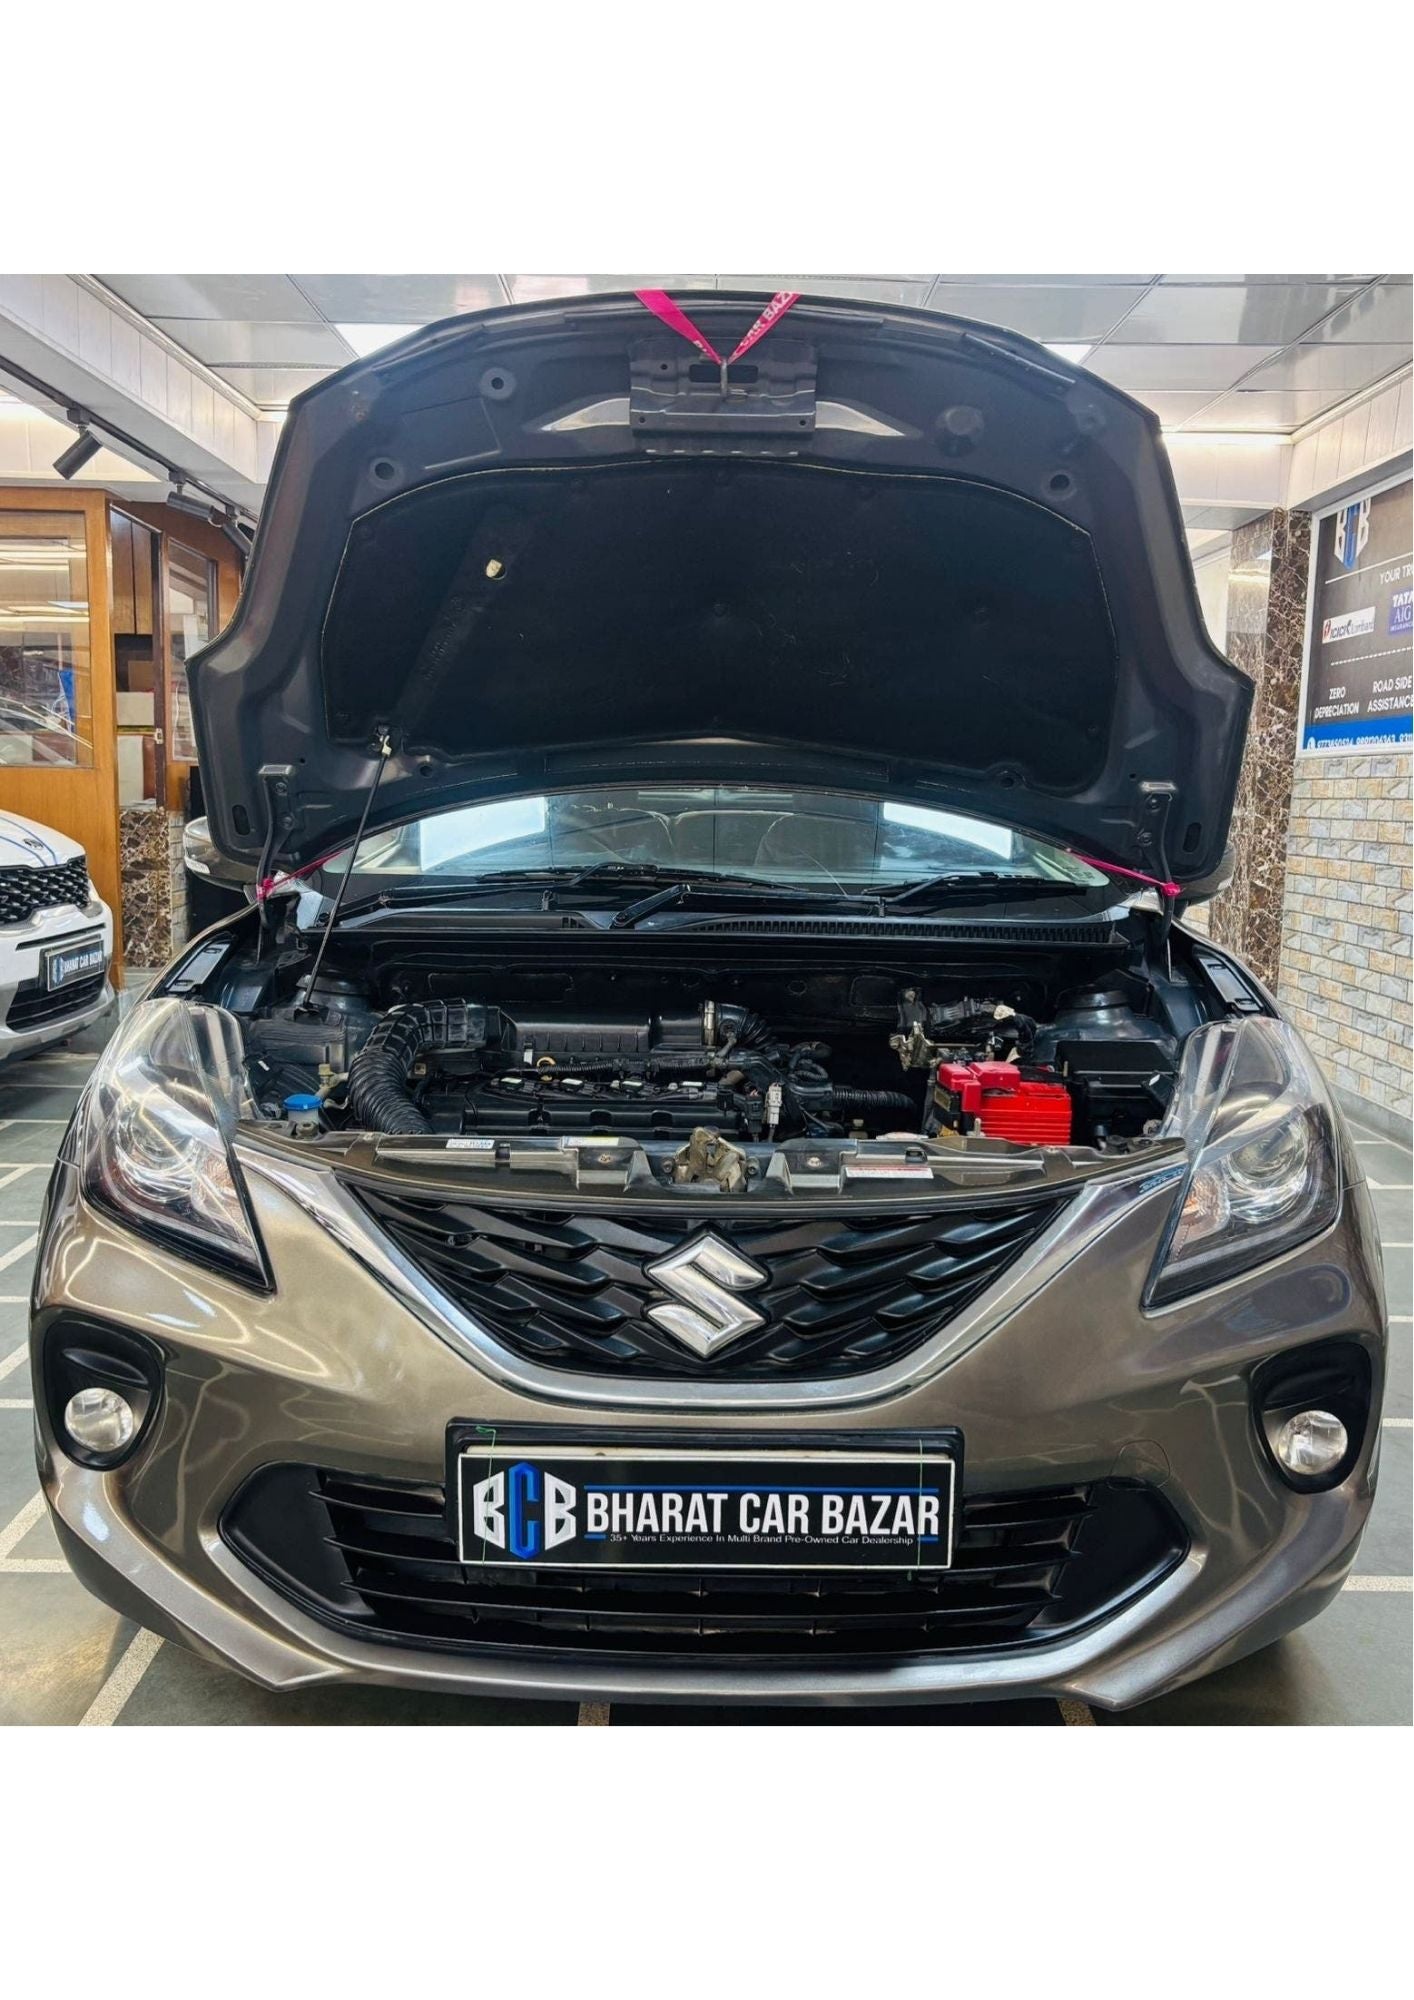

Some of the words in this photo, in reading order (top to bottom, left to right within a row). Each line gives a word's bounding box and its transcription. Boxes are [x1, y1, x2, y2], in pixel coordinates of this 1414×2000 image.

[1380, 567, 1401, 584] YOUR
[1394, 605, 1411, 623] AIG
[1329, 686, 1346, 700] ZERO
[1372, 679, 1394, 693] ROAD
[1395, 675, 1412, 690] SIDE
[1314, 701, 1360, 719] DEPRECIATION
[587, 1492, 728, 1533] BHARAT
[739, 1493, 809, 1534] CAR
[821, 1494, 939, 1535] BAZAR
[610, 1533, 627, 1542] 35+
[631, 1533, 656, 1543] Years
[659, 1534, 713, 1545] Experience
[716, 1534, 725, 1543] In
[728, 1534, 750, 1543] Multi
[753, 1535, 782, 1544] Brand
[785, 1535, 838, 1544] Pre-Owned
[841, 1535, 859, 1544] Car
[861, 1536, 914, 1546] Dealership
